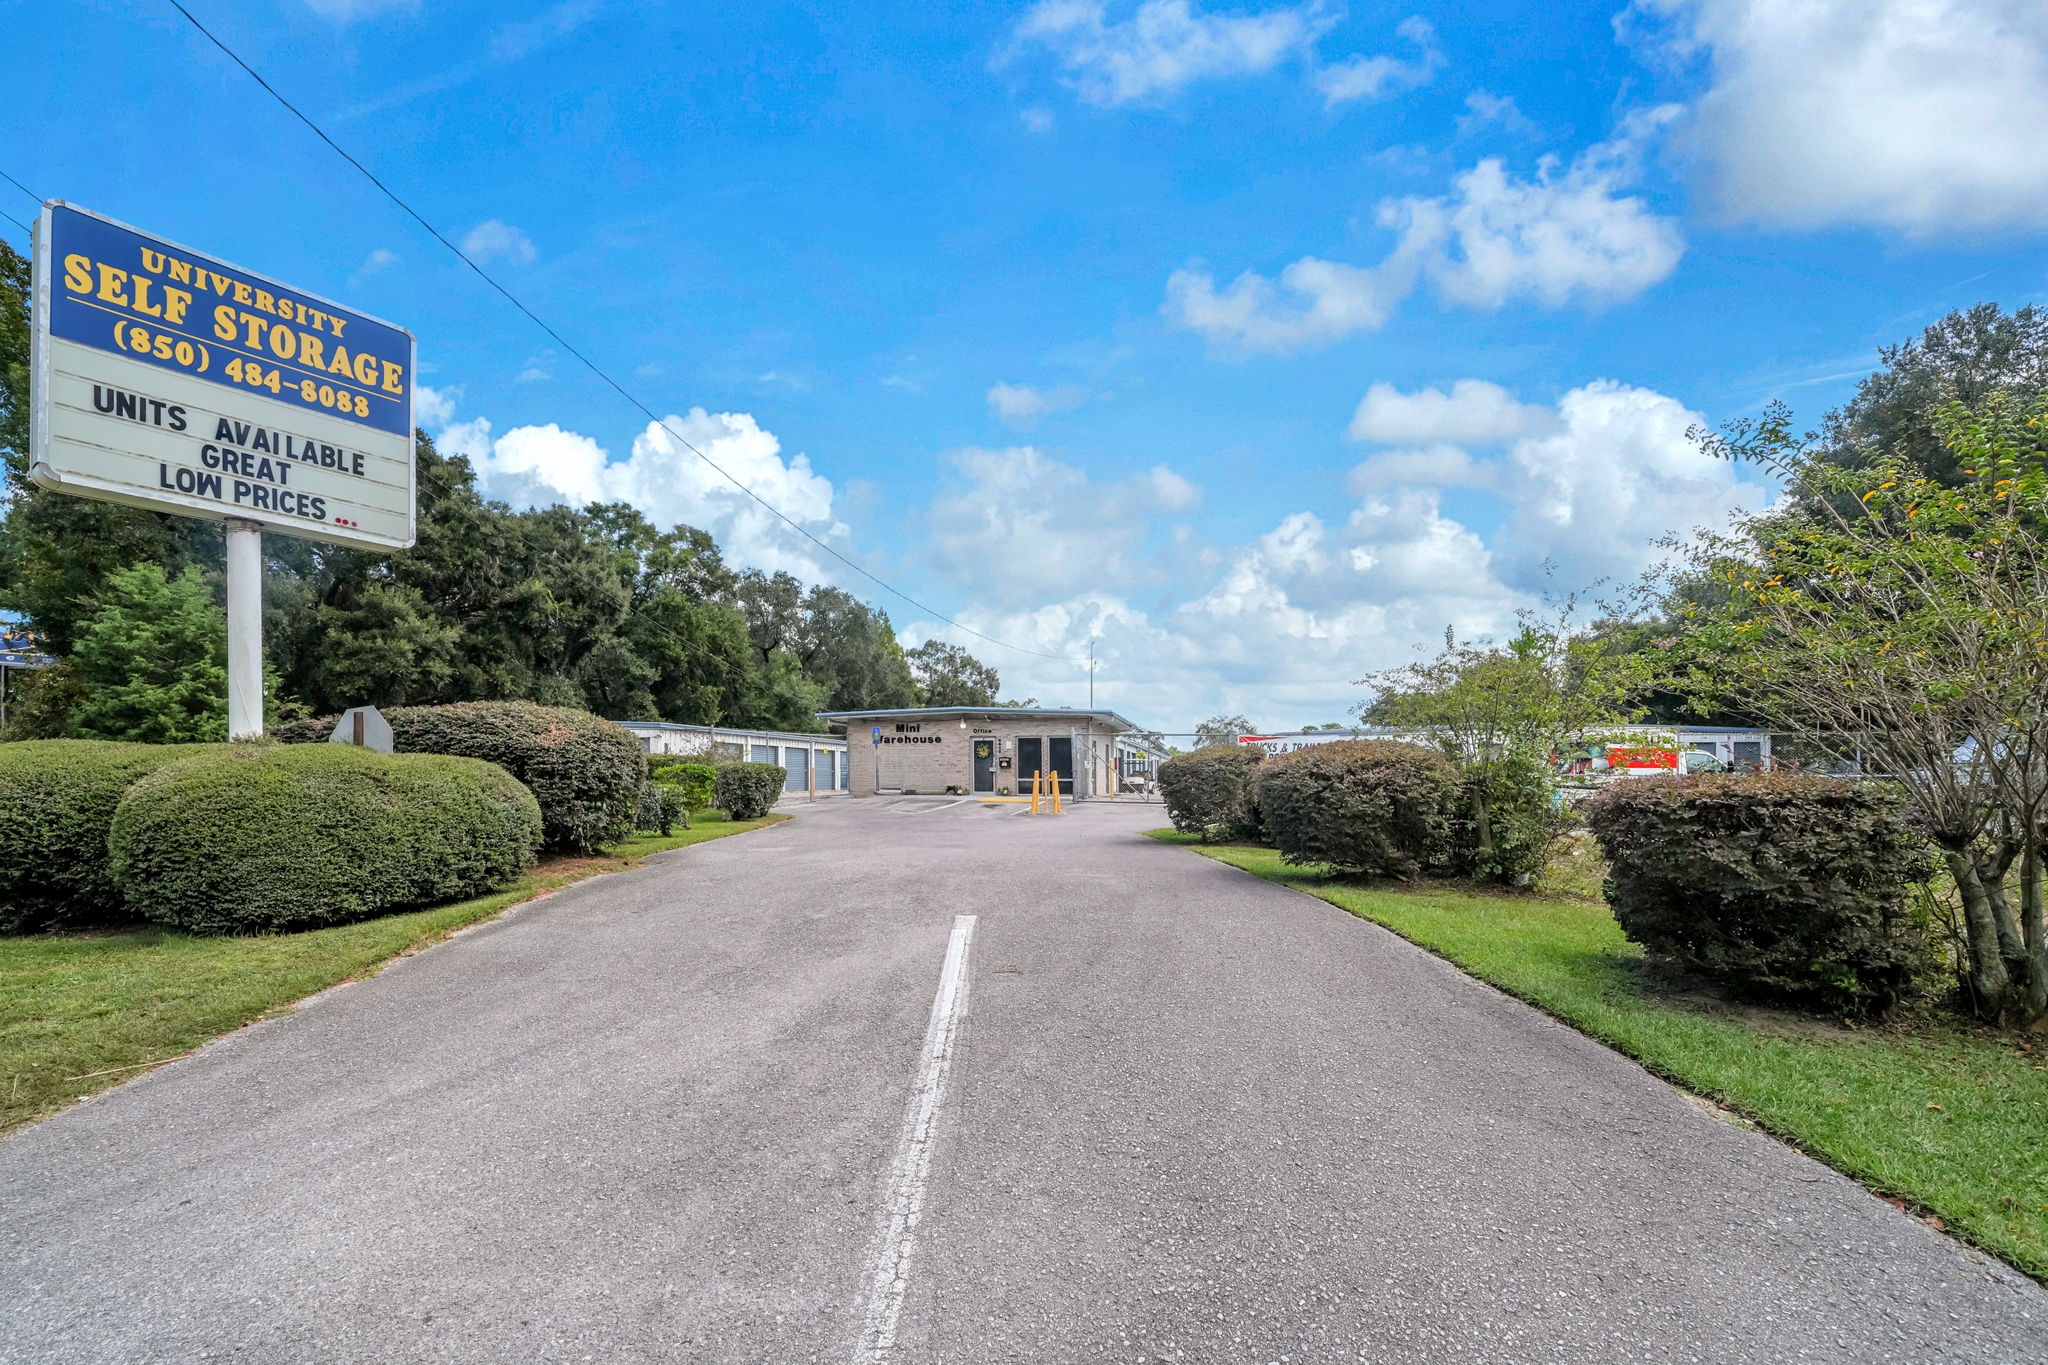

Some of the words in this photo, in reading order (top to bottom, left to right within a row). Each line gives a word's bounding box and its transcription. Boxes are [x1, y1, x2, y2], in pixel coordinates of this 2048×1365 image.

[64, 253, 192, 325] SELF
[213, 304, 403, 394] STORAGE
[140, 247, 347, 337] UNIVERSITY
[114, 320, 210, 372] (850)
[225, 357, 370, 418] 484-8088
[93, 384, 188, 431] UNITS
[215, 418, 365, 476] AVAILABLE
[201, 444, 291, 485] GREAT
[160, 463, 222, 499] LOW
[895, 724, 920, 733] Mini
